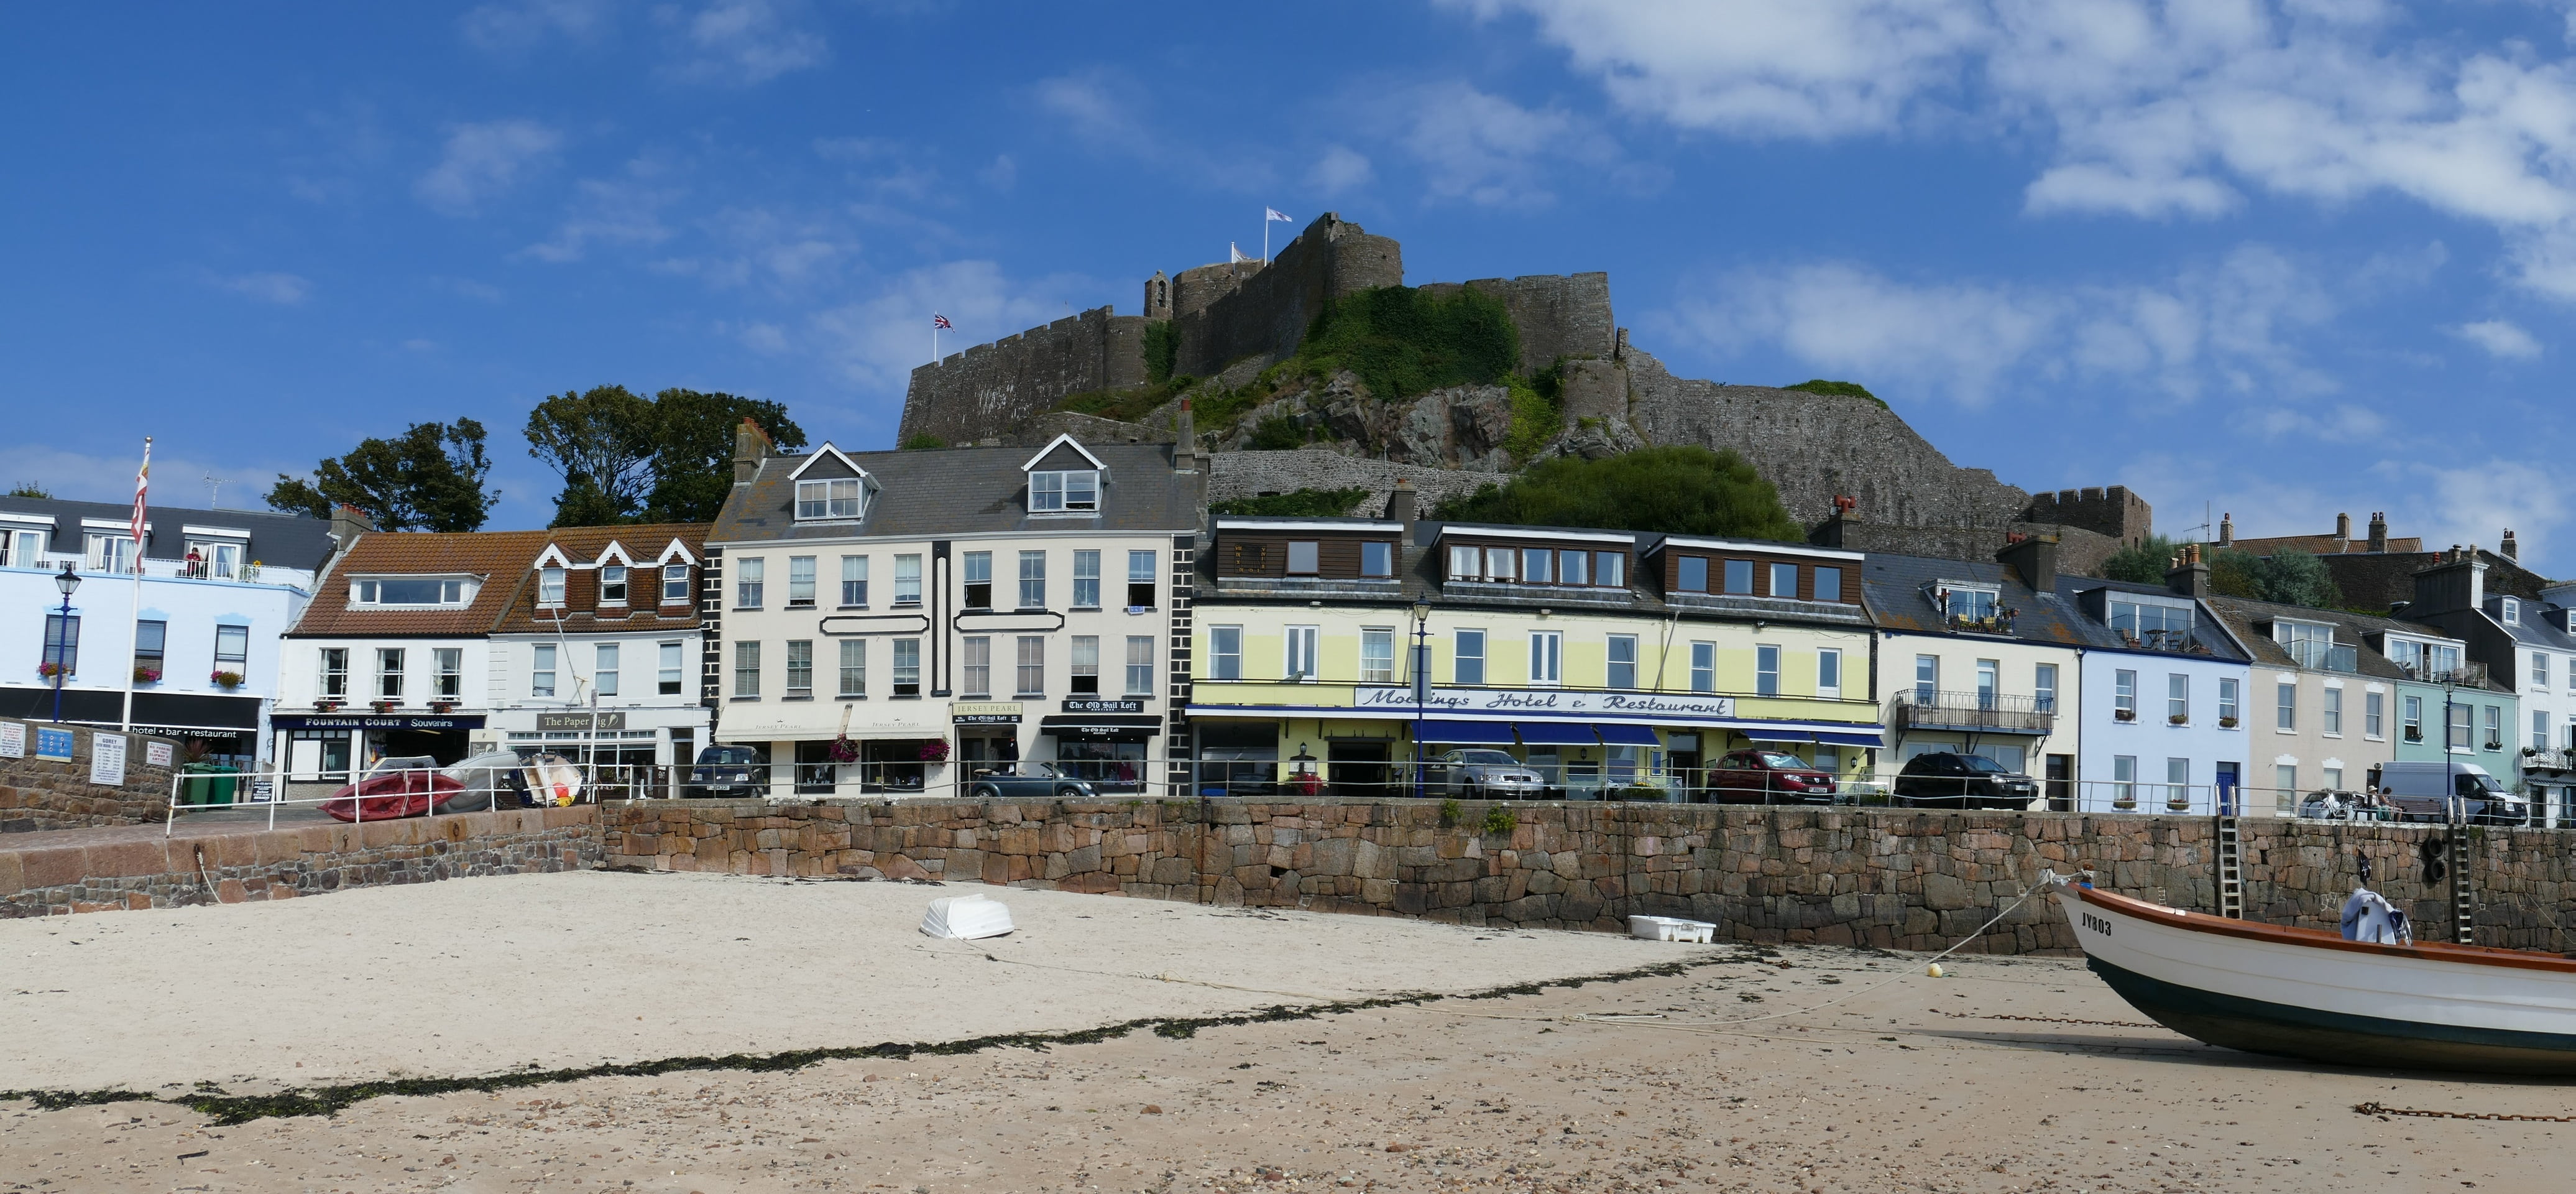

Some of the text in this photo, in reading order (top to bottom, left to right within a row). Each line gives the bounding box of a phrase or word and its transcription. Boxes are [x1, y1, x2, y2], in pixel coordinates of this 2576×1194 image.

[1363, 689, 1470, 708] Mooings
[1486, 693, 1558, 708] Hotel
[1603, 695, 1726, 715] Restaurant
[365, 718, 401, 726] COURT
[410, 718, 453, 727] Souvenirs
[545, 717, 562, 726] The
[564, 717, 589, 728] Paper
[132, 726, 156, 734] hotel
[166, 728, 182, 736] bar
